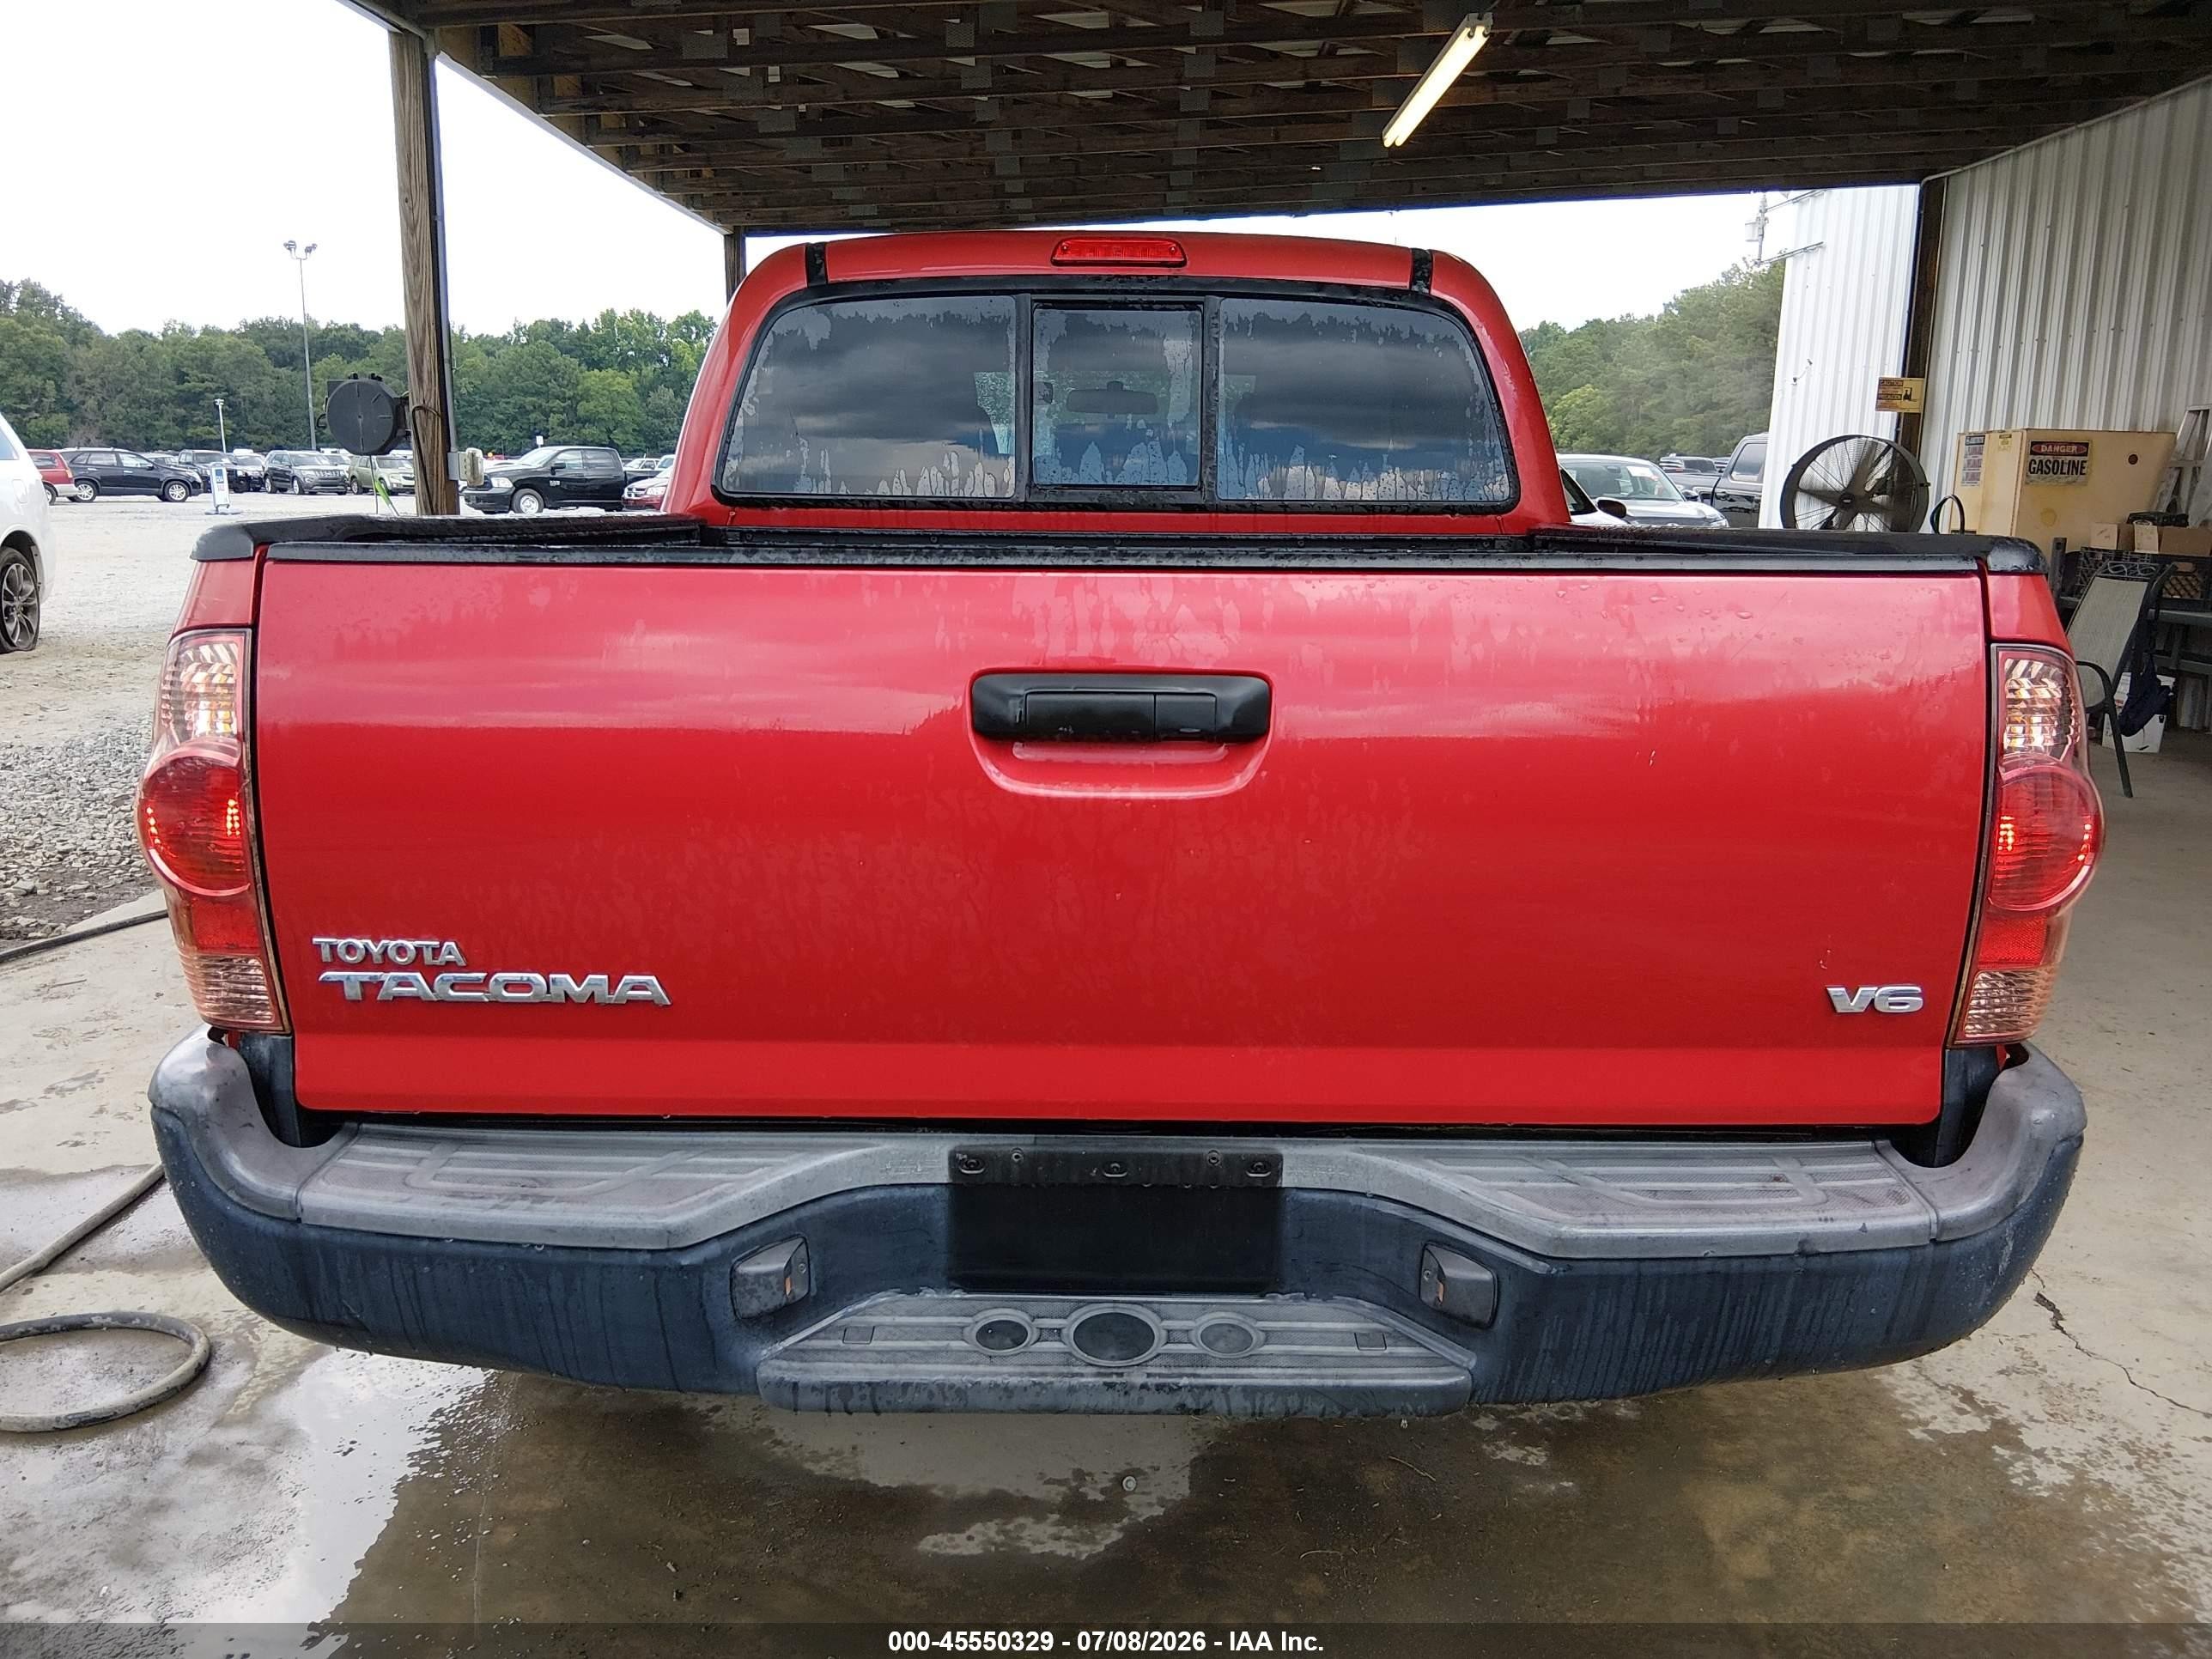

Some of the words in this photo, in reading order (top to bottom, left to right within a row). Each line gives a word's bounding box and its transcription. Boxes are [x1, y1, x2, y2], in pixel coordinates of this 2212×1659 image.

[2028, 459, 2087, 475] GASOLINE
[312, 938, 466, 967] TOYOTA
[319, 971, 672, 1006] TACOMA
[1826, 985, 1923, 1013] V6
